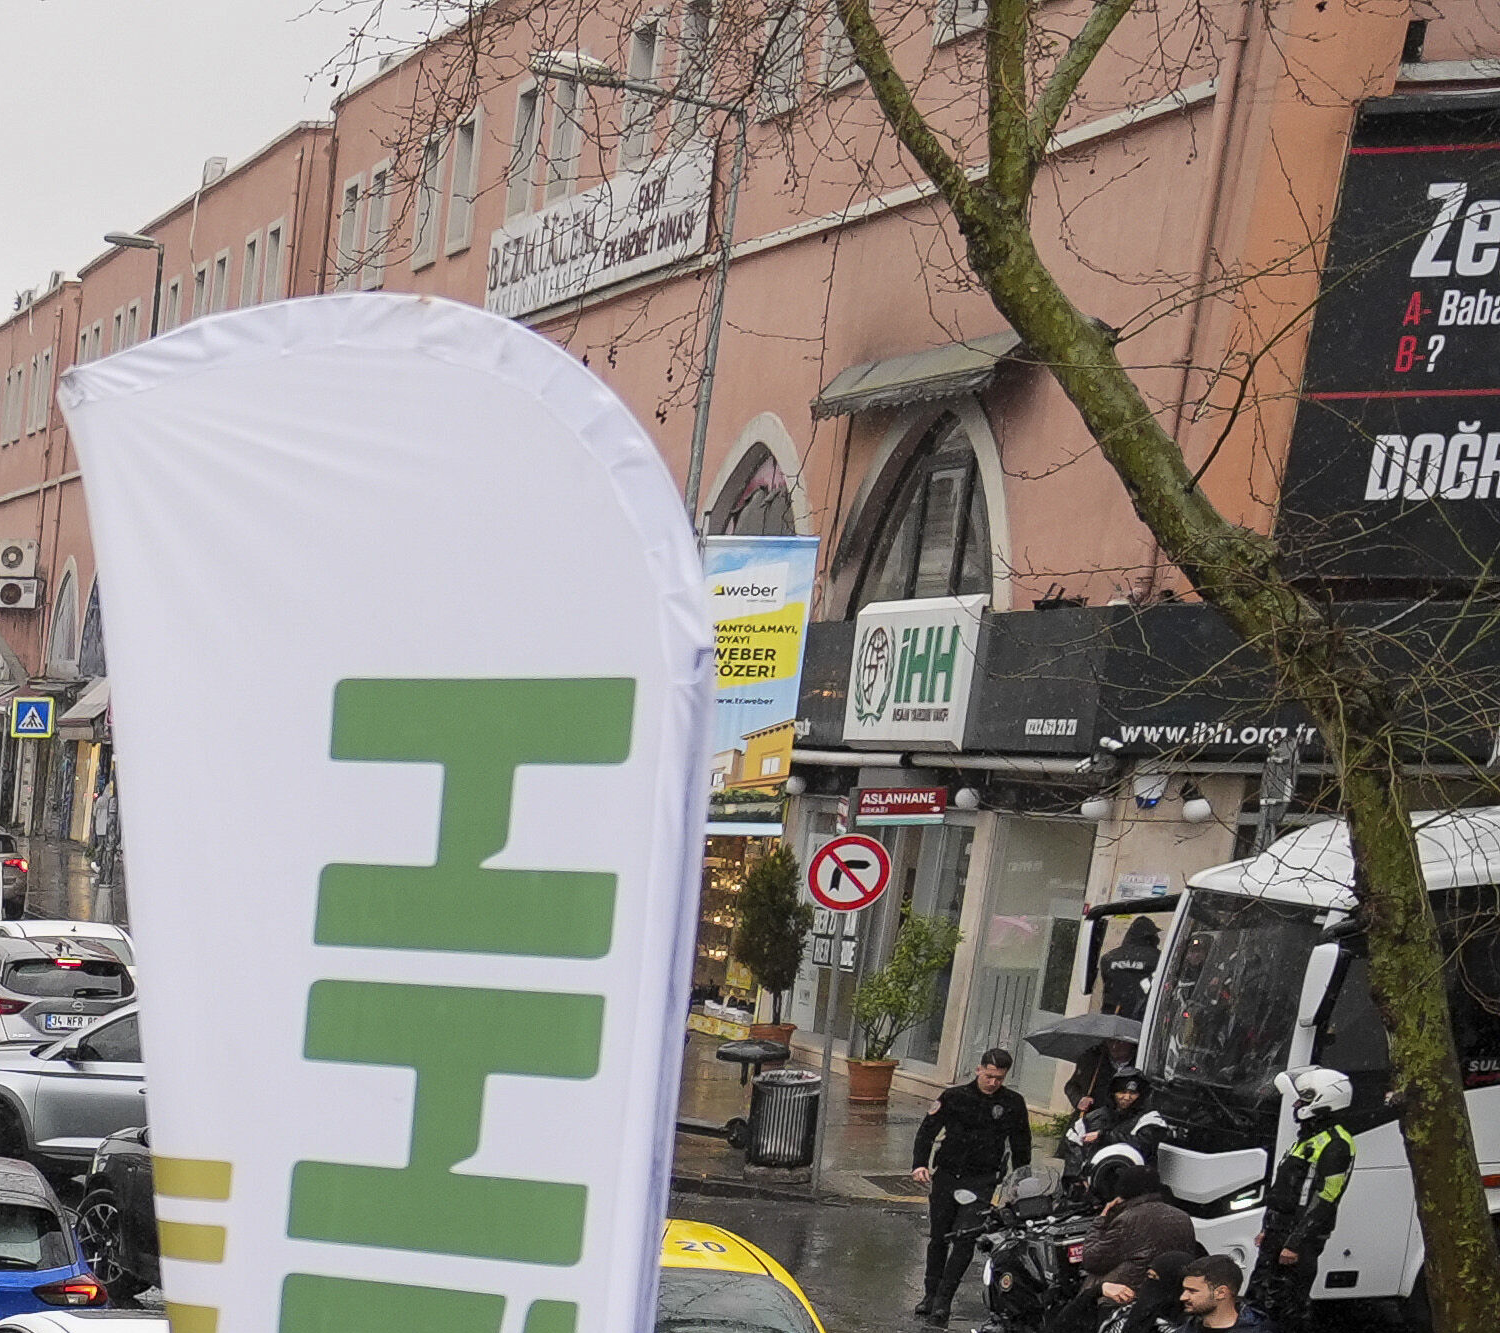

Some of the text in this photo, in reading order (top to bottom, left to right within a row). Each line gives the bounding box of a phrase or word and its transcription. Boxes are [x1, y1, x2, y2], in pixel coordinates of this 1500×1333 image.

[1426, 334, 1446, 372] ?
[726, 584, 778, 597] weber
[714, 636, 750, 644] OYAYI
[1120, 721, 1317, 747] www.ihh.orgtr
[862, 792, 937, 805] ASLANHANE
[51, 1014, 62, 1027] 34
